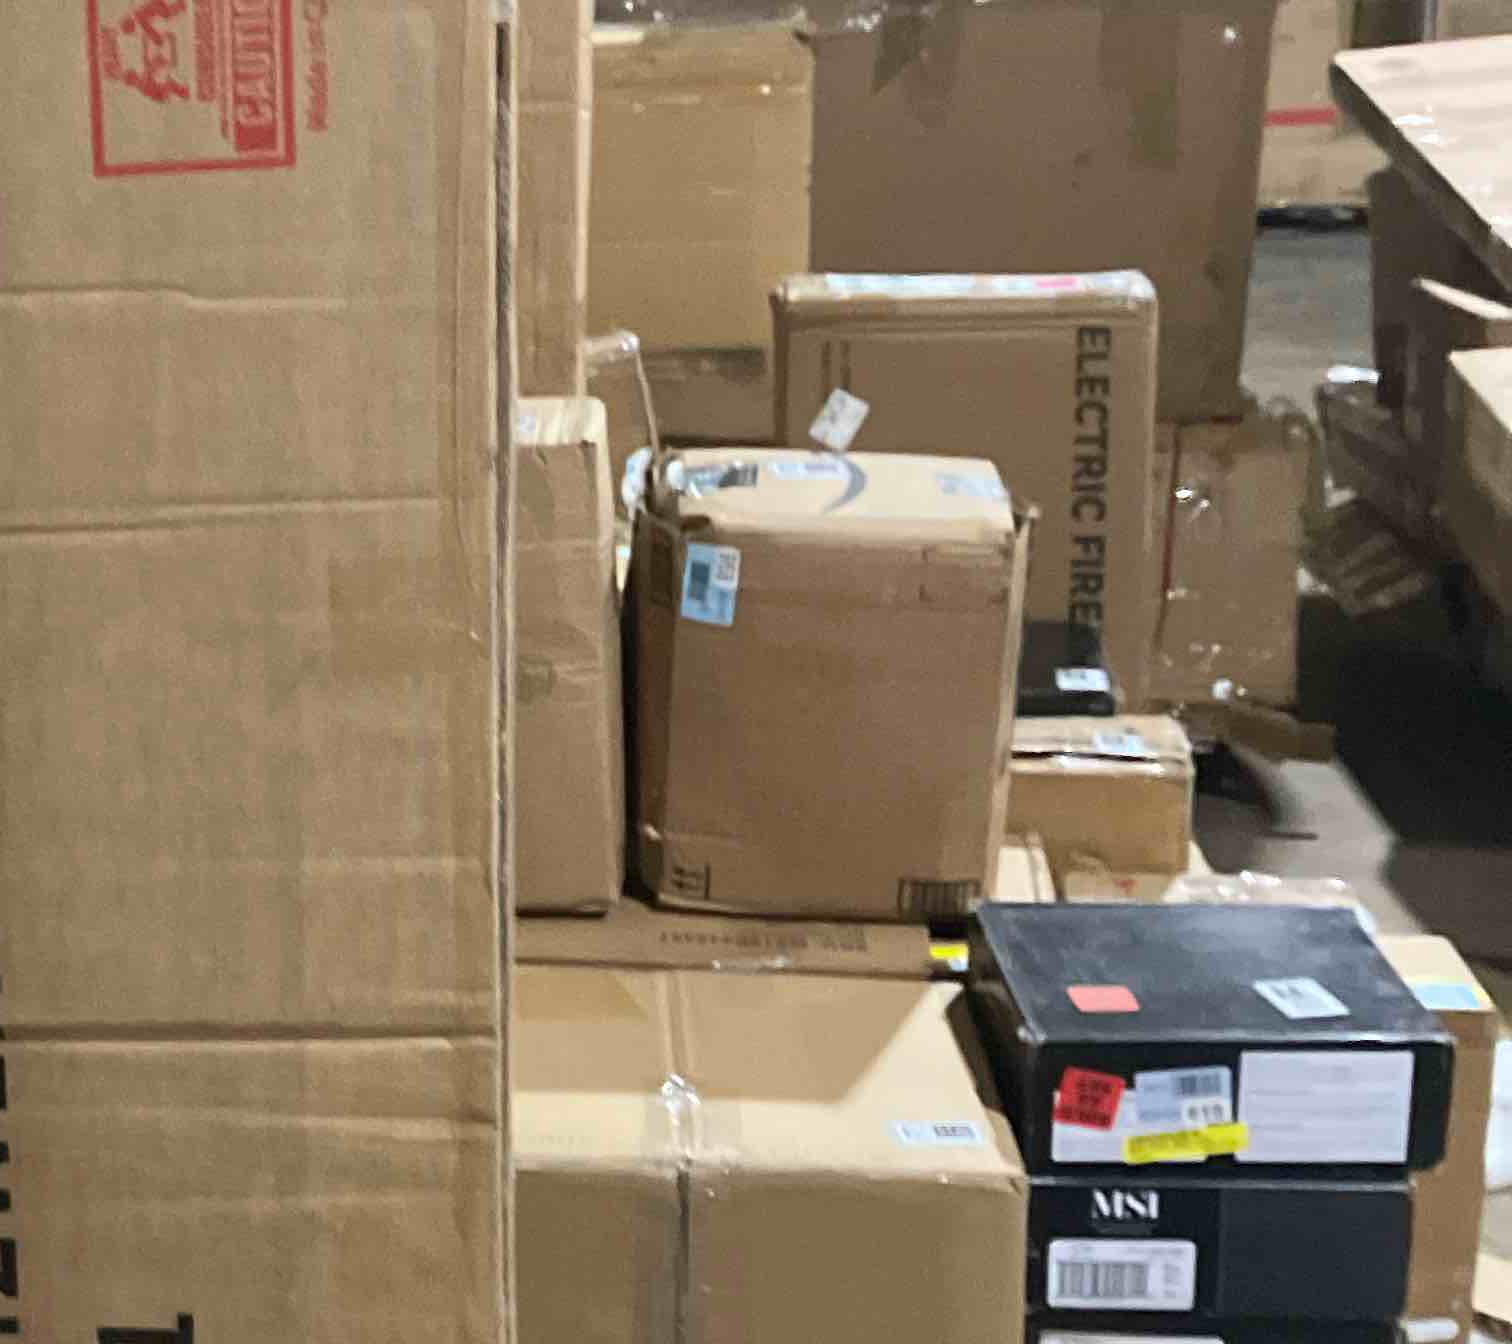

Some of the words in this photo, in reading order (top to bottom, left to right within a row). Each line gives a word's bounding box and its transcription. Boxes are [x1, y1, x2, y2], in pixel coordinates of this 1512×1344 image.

[1072, 327, 1111, 523] ELECTRIC
[1067, 536, 1105, 628] FIRE
[1092, 1189, 1158, 1219] MSI
